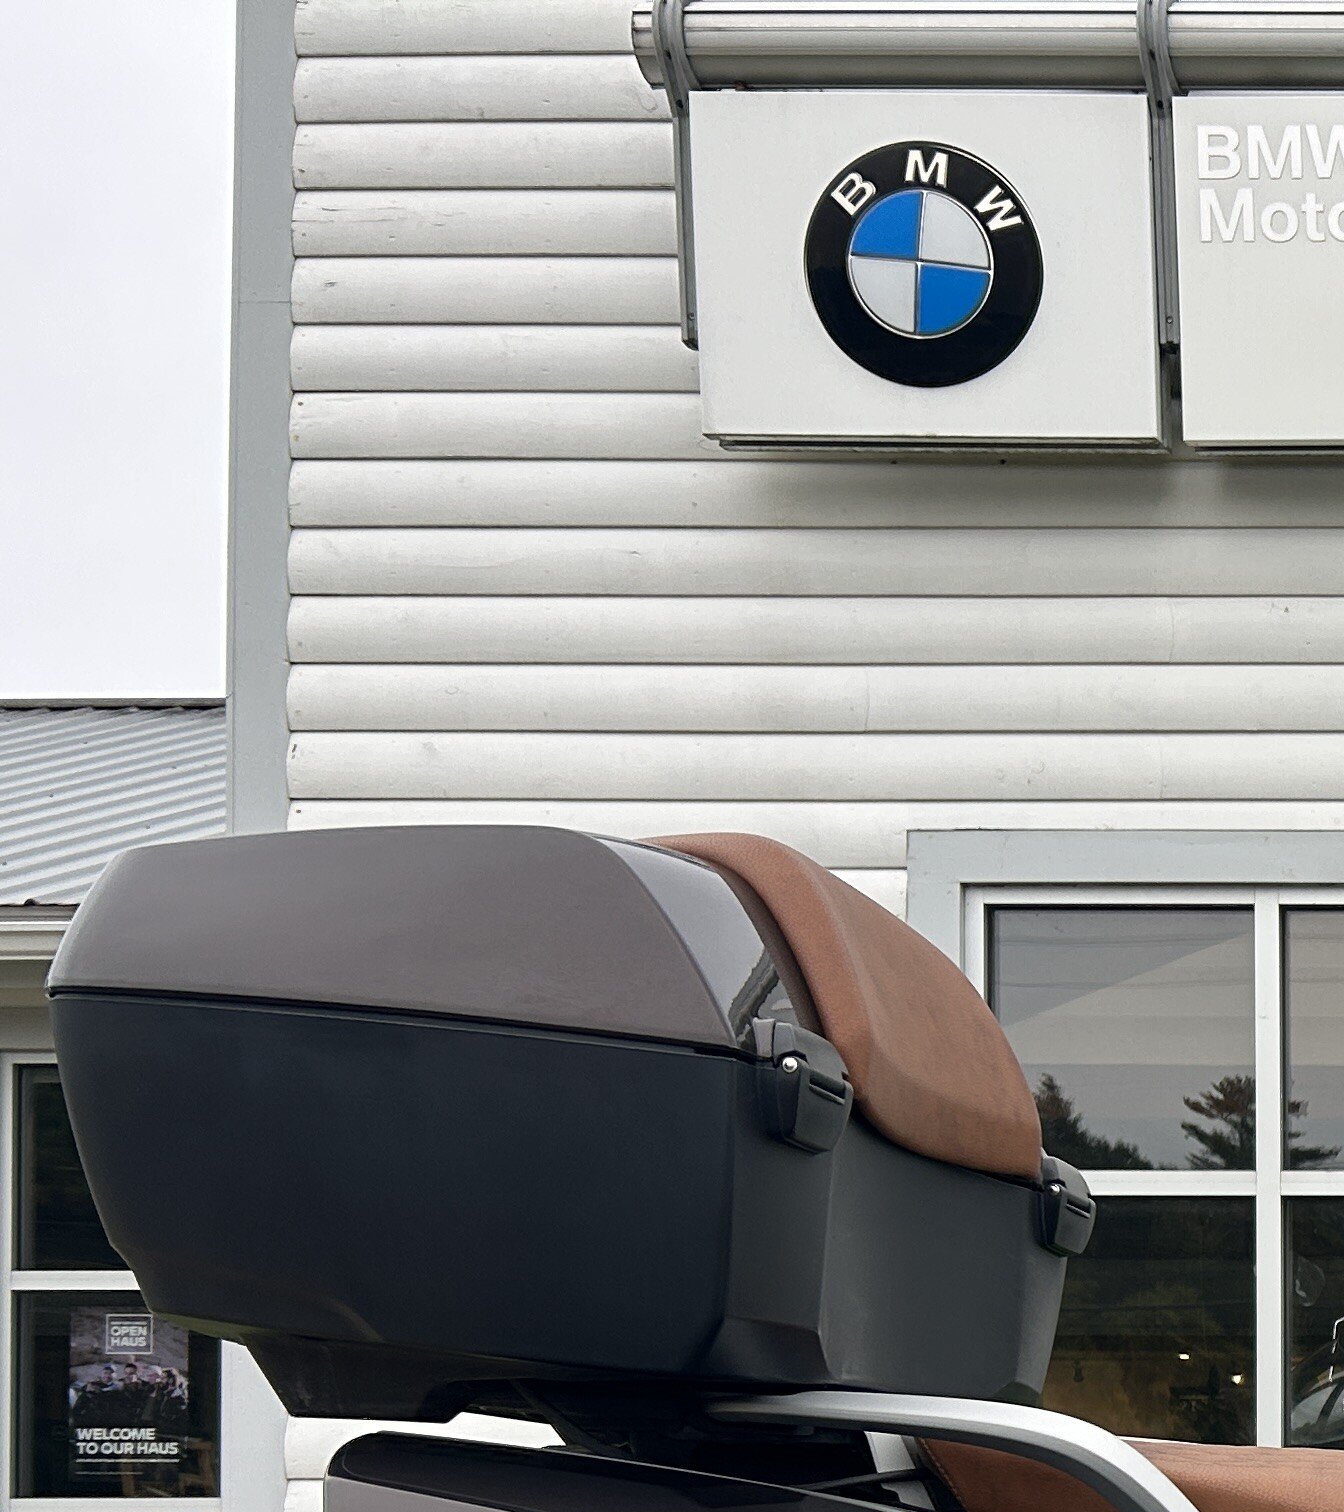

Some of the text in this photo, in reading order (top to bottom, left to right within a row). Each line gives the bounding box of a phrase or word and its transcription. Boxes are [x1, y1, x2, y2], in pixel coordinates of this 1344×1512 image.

[830, 149, 1025, 231] BMW
[110, 1326, 148, 1337] OPEN
[110, 1336, 147, 1348] HAUS
[75, 1427, 157, 1441] WELCOME
[76, 1441, 180, 1455] TO OUR HAUS
